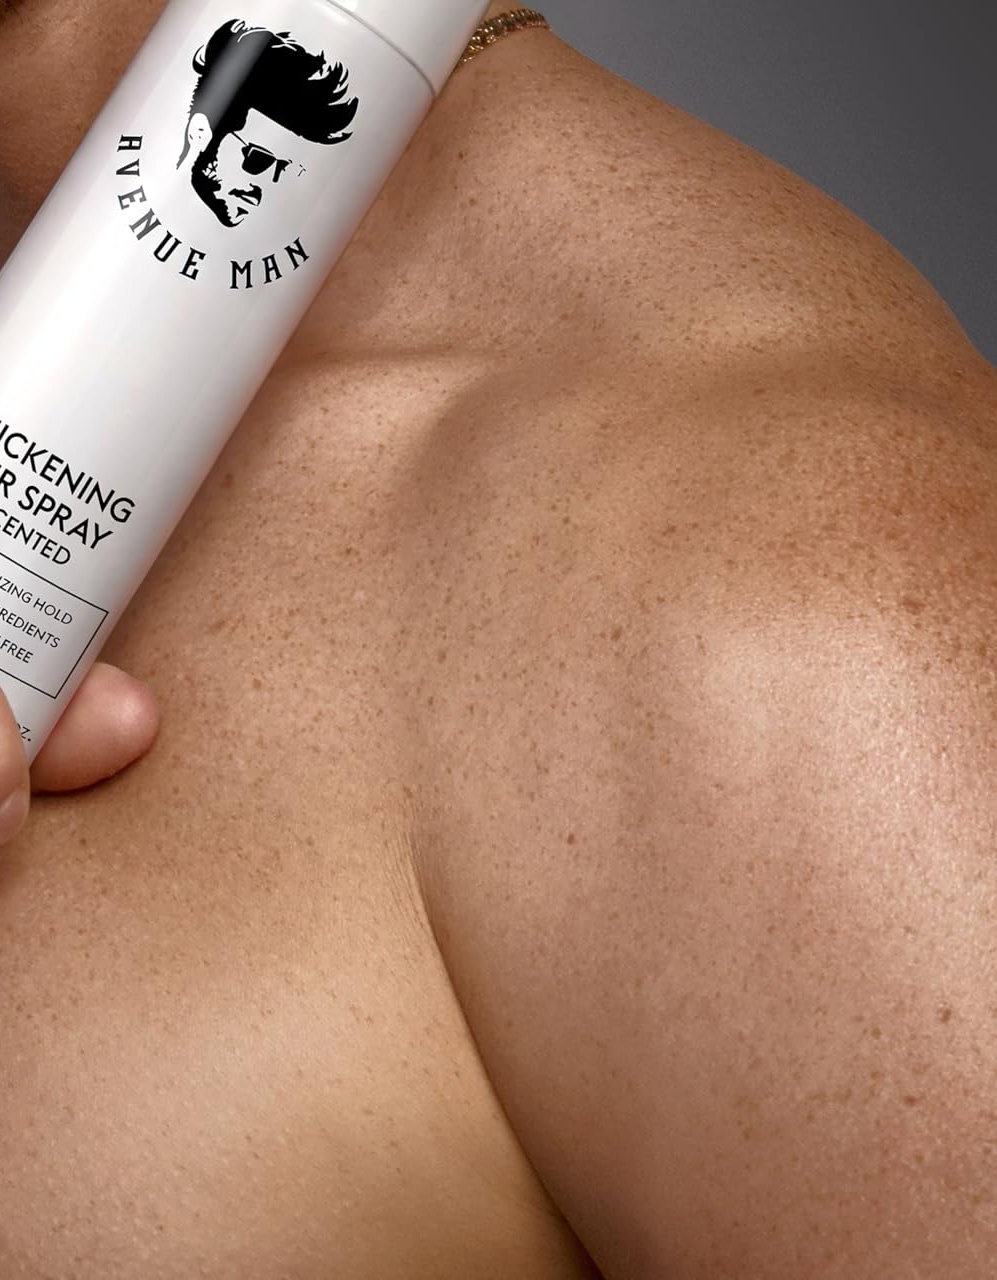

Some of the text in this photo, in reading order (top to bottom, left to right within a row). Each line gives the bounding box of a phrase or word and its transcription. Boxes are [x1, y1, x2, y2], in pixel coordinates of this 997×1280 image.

[116, 134, 310, 289] AVENUE MAN
[17, 484, 114, 550] SPRAY
[33, 597, 73, 625] HOLD
[0, 638, 34, 664] FREE
[16, 722, 32, 742] Z.
